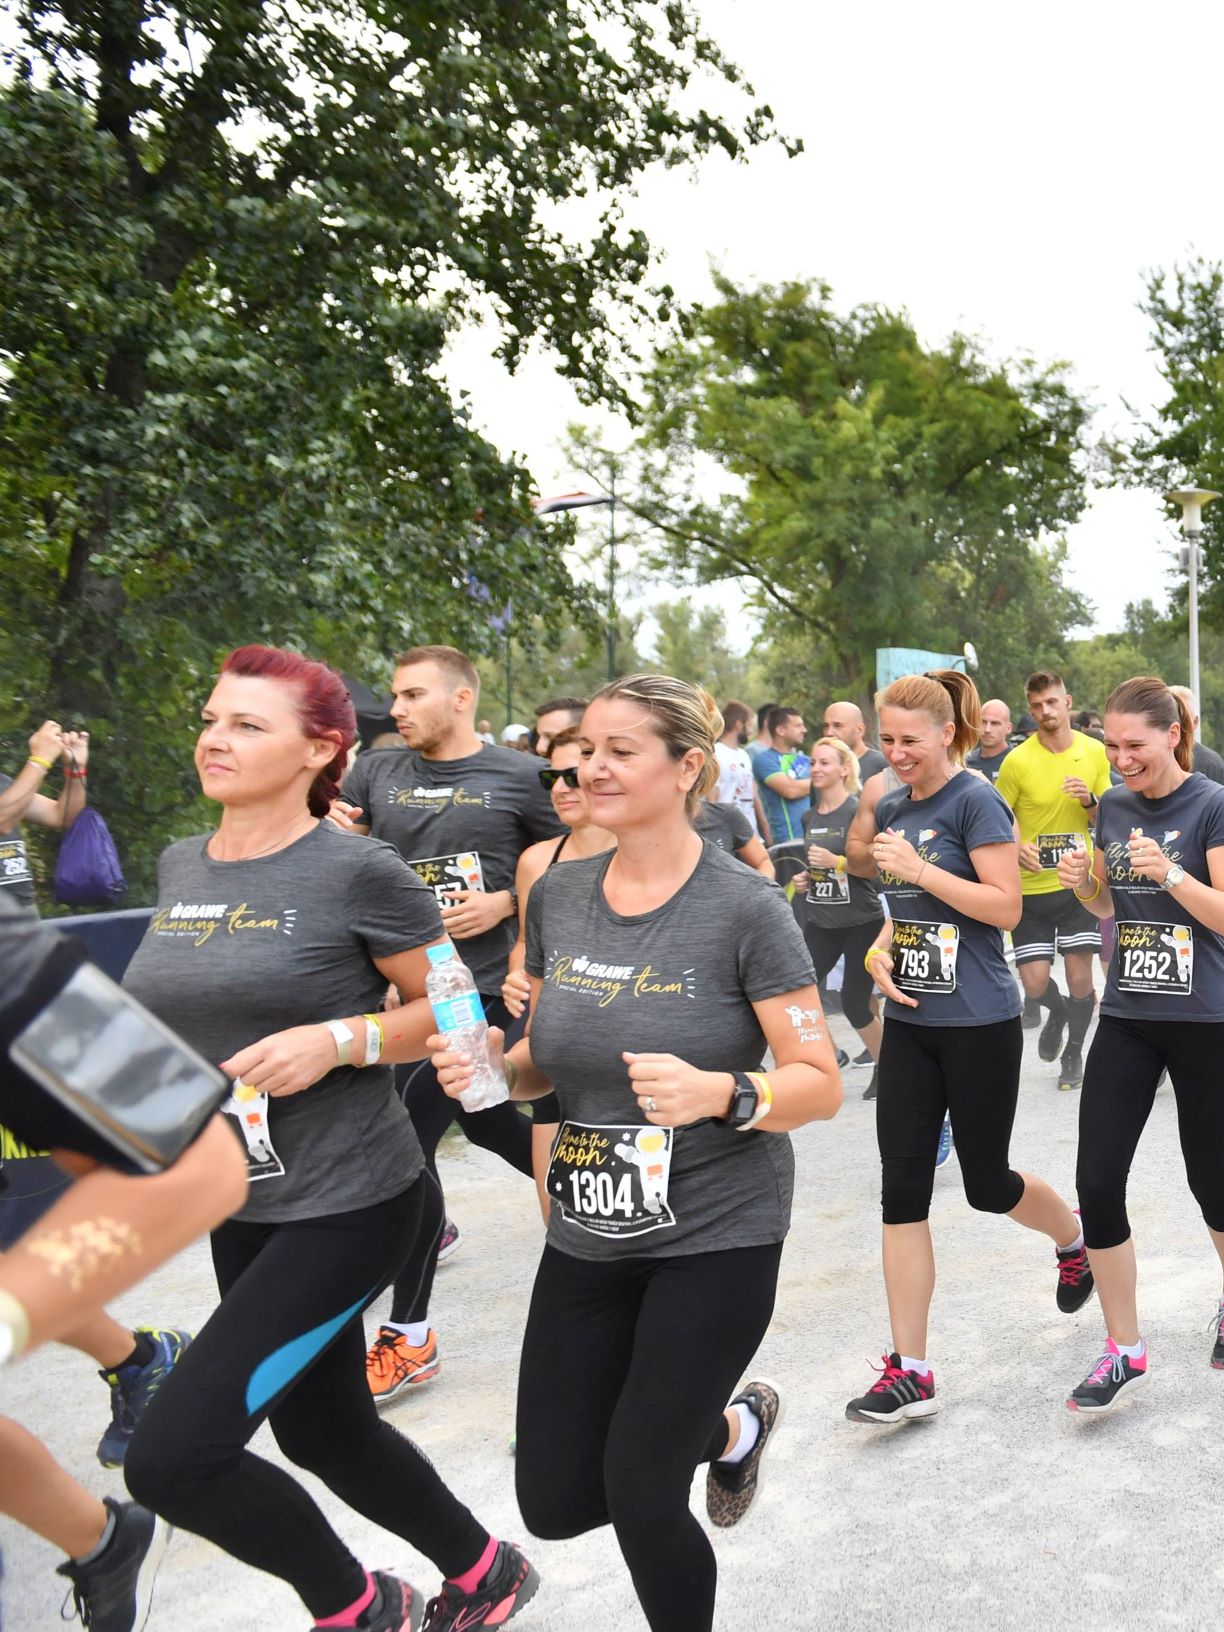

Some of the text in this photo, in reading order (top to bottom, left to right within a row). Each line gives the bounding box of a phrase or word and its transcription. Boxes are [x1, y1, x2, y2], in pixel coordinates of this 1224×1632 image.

[815, 882, 833, 897] 227
[180, 904, 228, 918] GRAWE
[225, 903, 279, 934] team
[585, 962, 635, 980] GRAWE
[899, 947, 930, 978] 793
[1123, 949, 1172, 980] 1252
[551, 956, 683, 1008] Running team
[569, 1169, 635, 1217] 1304
